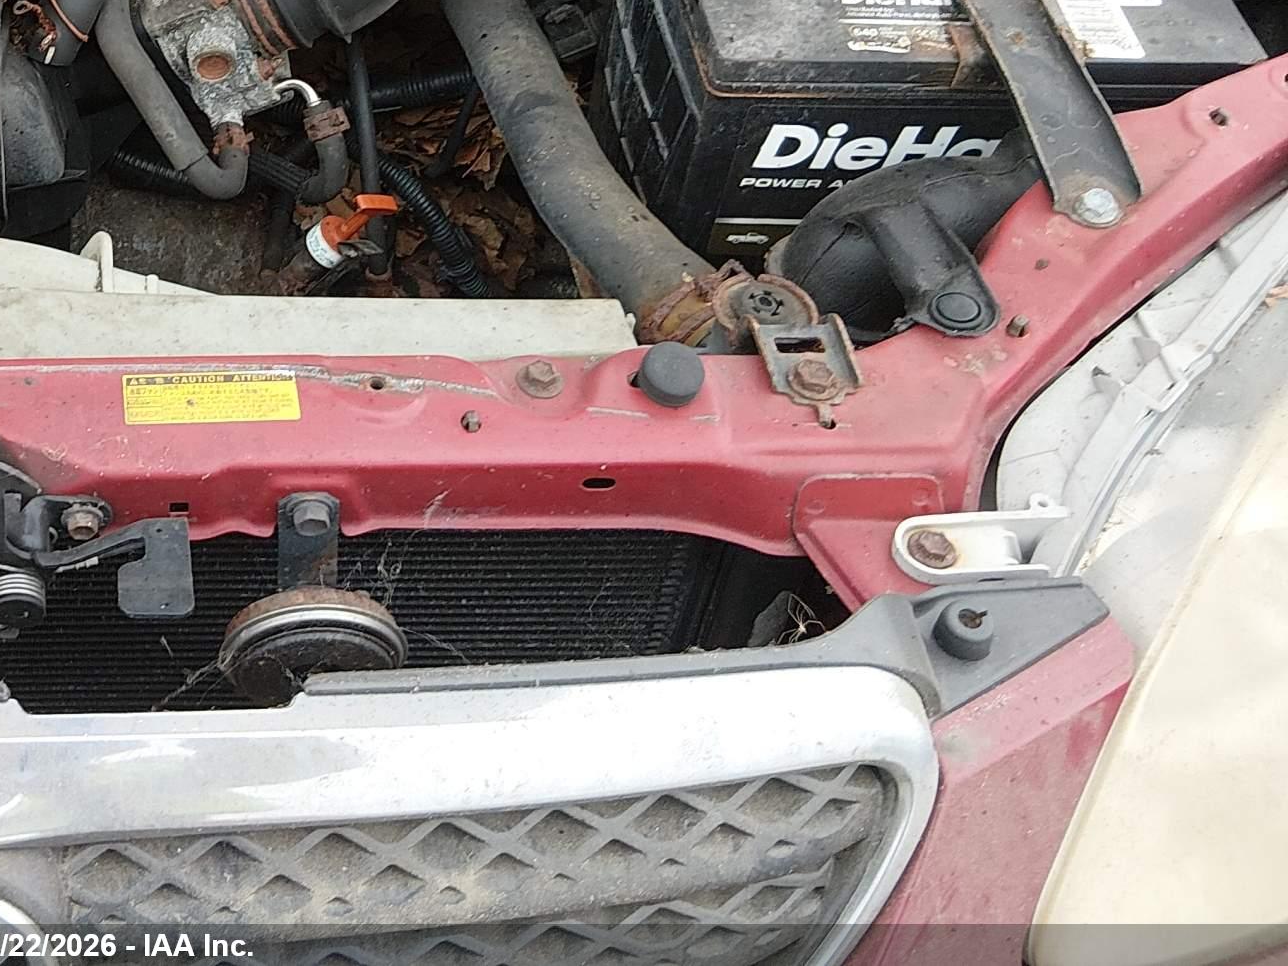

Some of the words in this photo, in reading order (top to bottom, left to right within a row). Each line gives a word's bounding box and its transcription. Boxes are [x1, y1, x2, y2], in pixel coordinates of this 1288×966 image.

[739, 177, 822, 188] POWER
[827, 178, 853, 188] A
[172, 375, 225, 384] CAUTION
